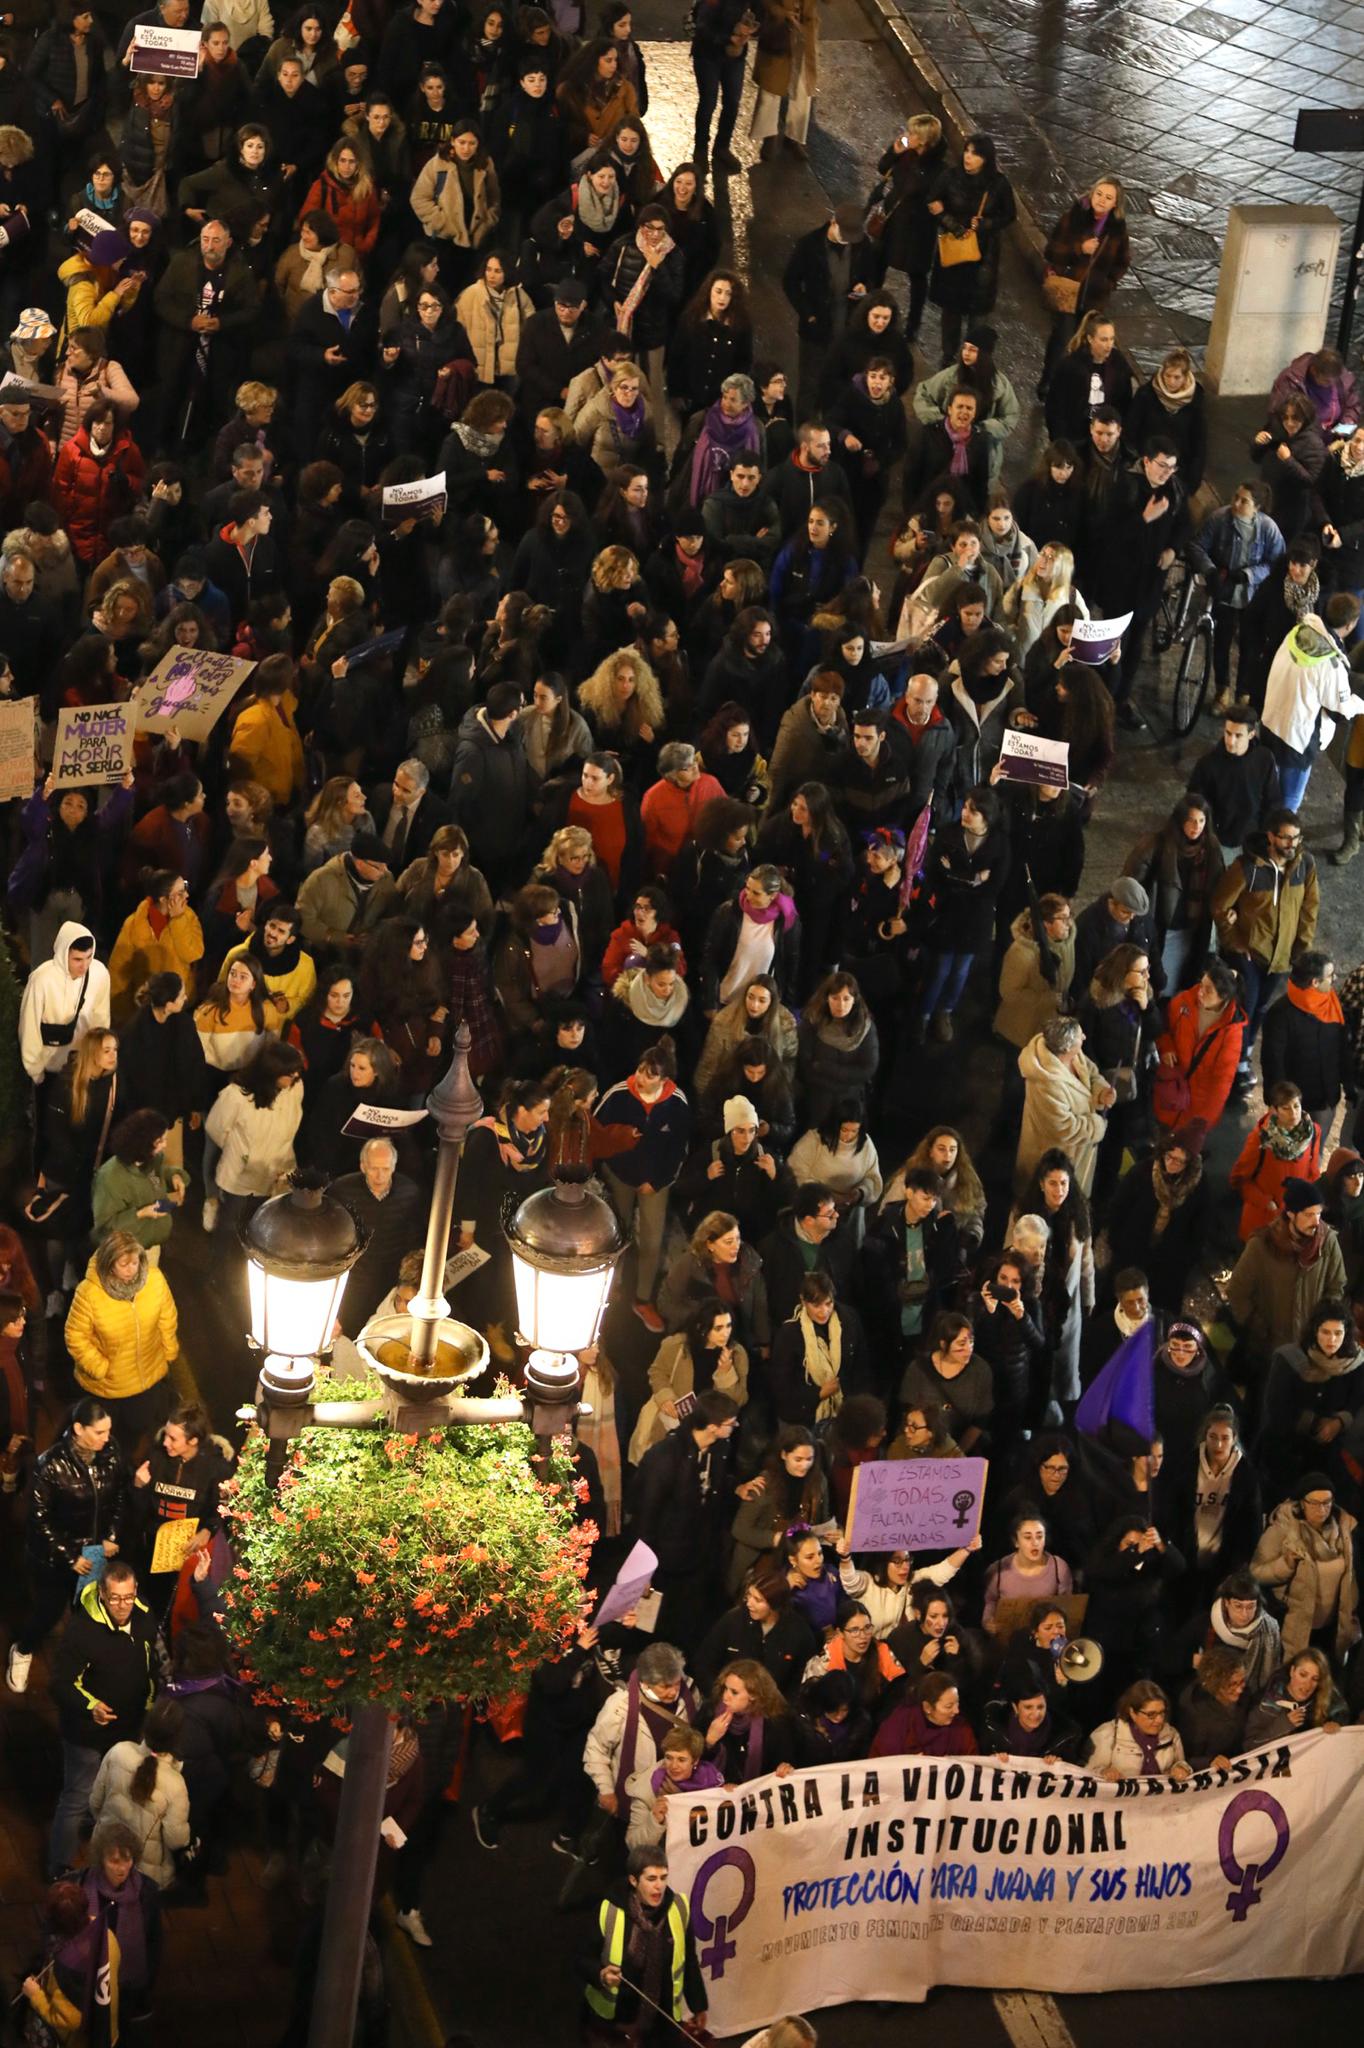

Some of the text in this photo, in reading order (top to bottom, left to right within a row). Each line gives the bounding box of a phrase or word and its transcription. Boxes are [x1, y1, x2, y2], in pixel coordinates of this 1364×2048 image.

[140, 34, 173, 42] ESTAMOS
[389, 489, 422, 498] ESTAMOS
[394, 494, 418, 502] TODAS
[74, 712, 91, 723] NO
[64, 718, 126, 740] MUJER
[80, 736, 108, 748] PARA
[1007, 740, 1039, 752] ESTAMOS
[1011, 734, 1021, 742] NO
[62, 744, 122, 764] MORIR
[1010, 747, 1034, 757] TODAS
[59, 760, 124, 778] POR SERLO
[362, 1110, 398, 1121] ESTAMOS
[366, 1116, 392, 1124] TODAS
[868, 1464, 962, 1484] NO ESTAMOS
[157, 1482, 193, 1498] NORWAY
[870, 1510, 948, 1528] FALTAN LAS
[862, 1530, 944, 1548] ASESINADAS
[689, 1778, 823, 1847] CONTRA
[840, 1771, 880, 1811] LA
[902, 1763, 1098, 1802] VIOLENCIA
[844, 1810, 1127, 1860] INSTITUCIONAL
[783, 1860, 925, 1921] PROTECCIÓN
[984, 1866, 1056, 1902] JUANA
[1067, 1866, 1084, 1902] Y
[1090, 1863, 1126, 1902] SUS
[1136, 1861, 1192, 1900] HIJOS
[760, 1920, 860, 1962] MOVIMIENTO
[950, 1914, 1032, 1934] GRANADA
[1038, 1916, 1049, 1933] Y
[1055, 1914, 1160, 1935] PLATAFORMA
